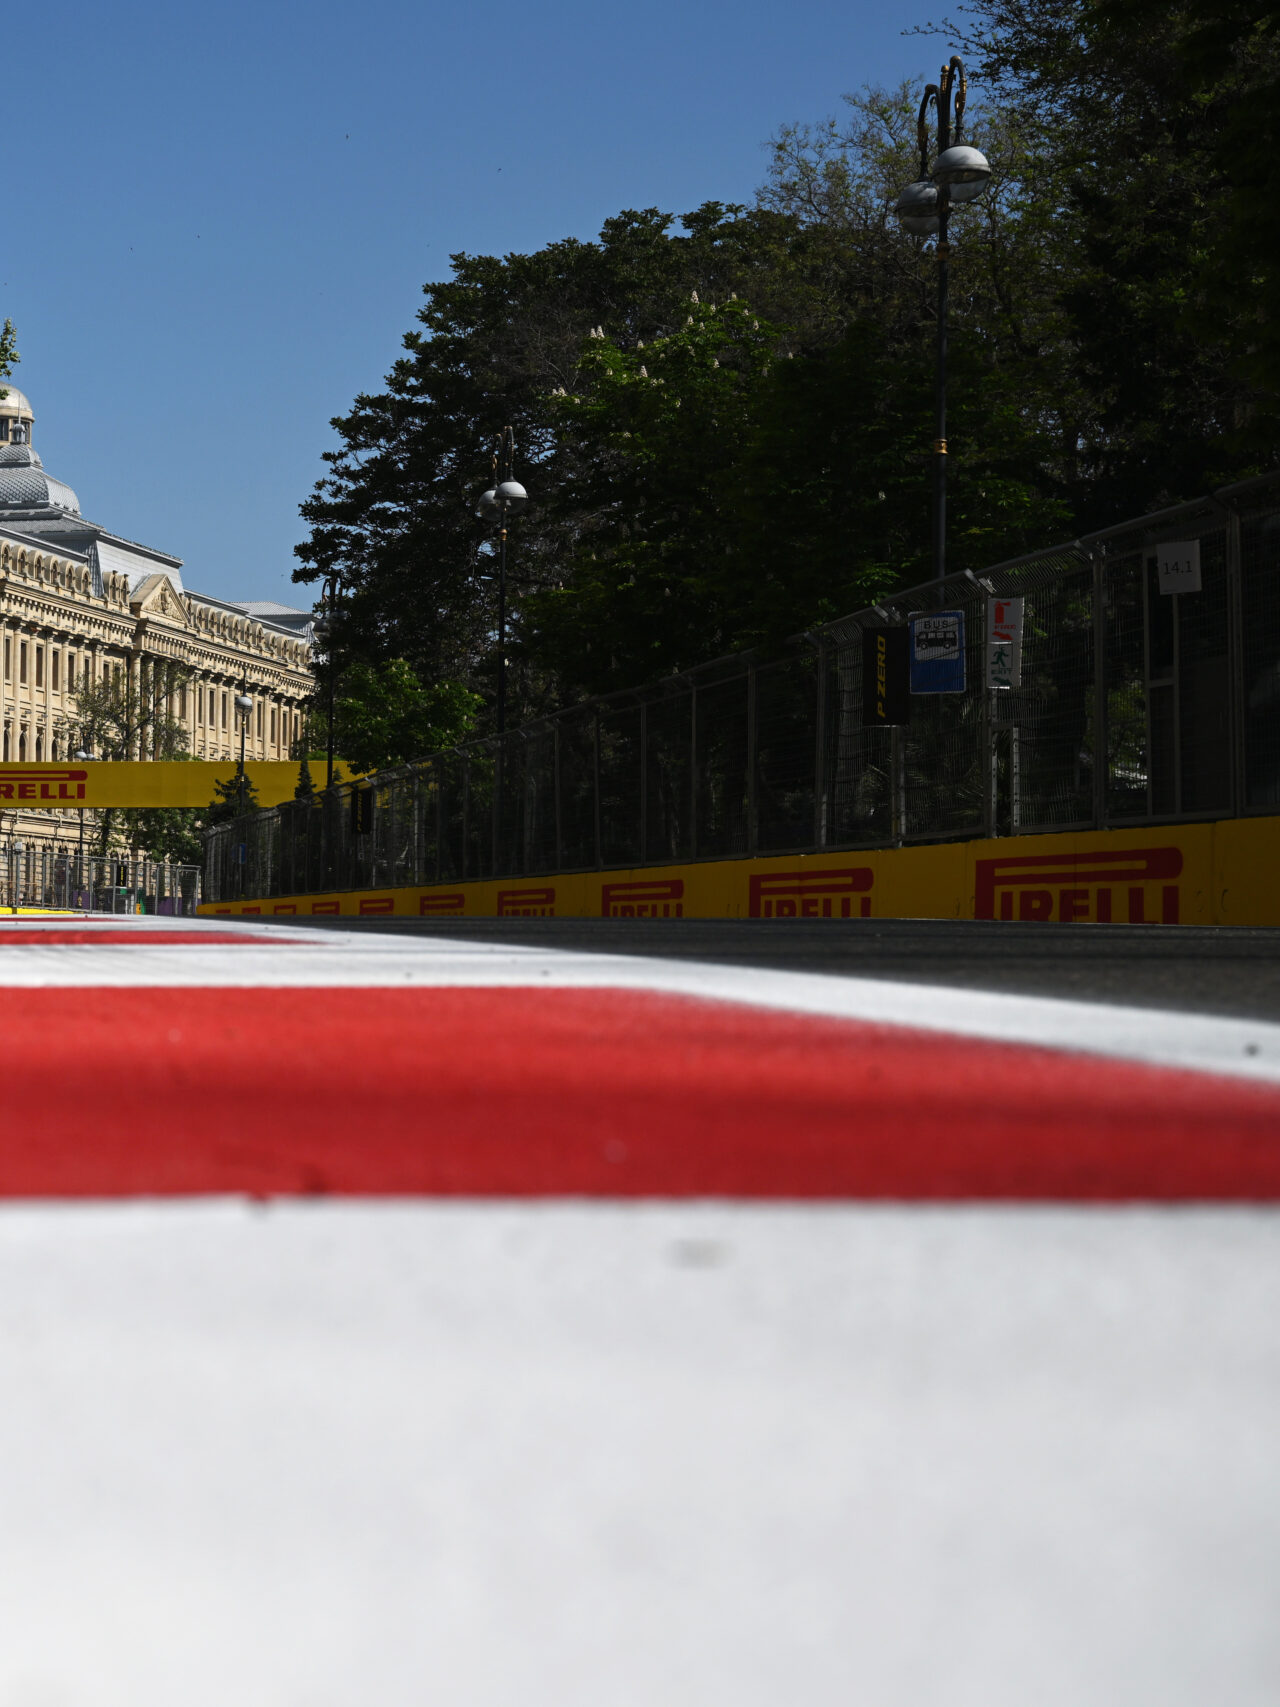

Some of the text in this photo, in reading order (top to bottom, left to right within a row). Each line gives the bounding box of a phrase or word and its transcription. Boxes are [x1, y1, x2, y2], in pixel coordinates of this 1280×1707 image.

[1163, 560, 1193, 575] 14.1
[924, 620, 949, 629] BUS
[877, 634, 887, 718] P ZERO
